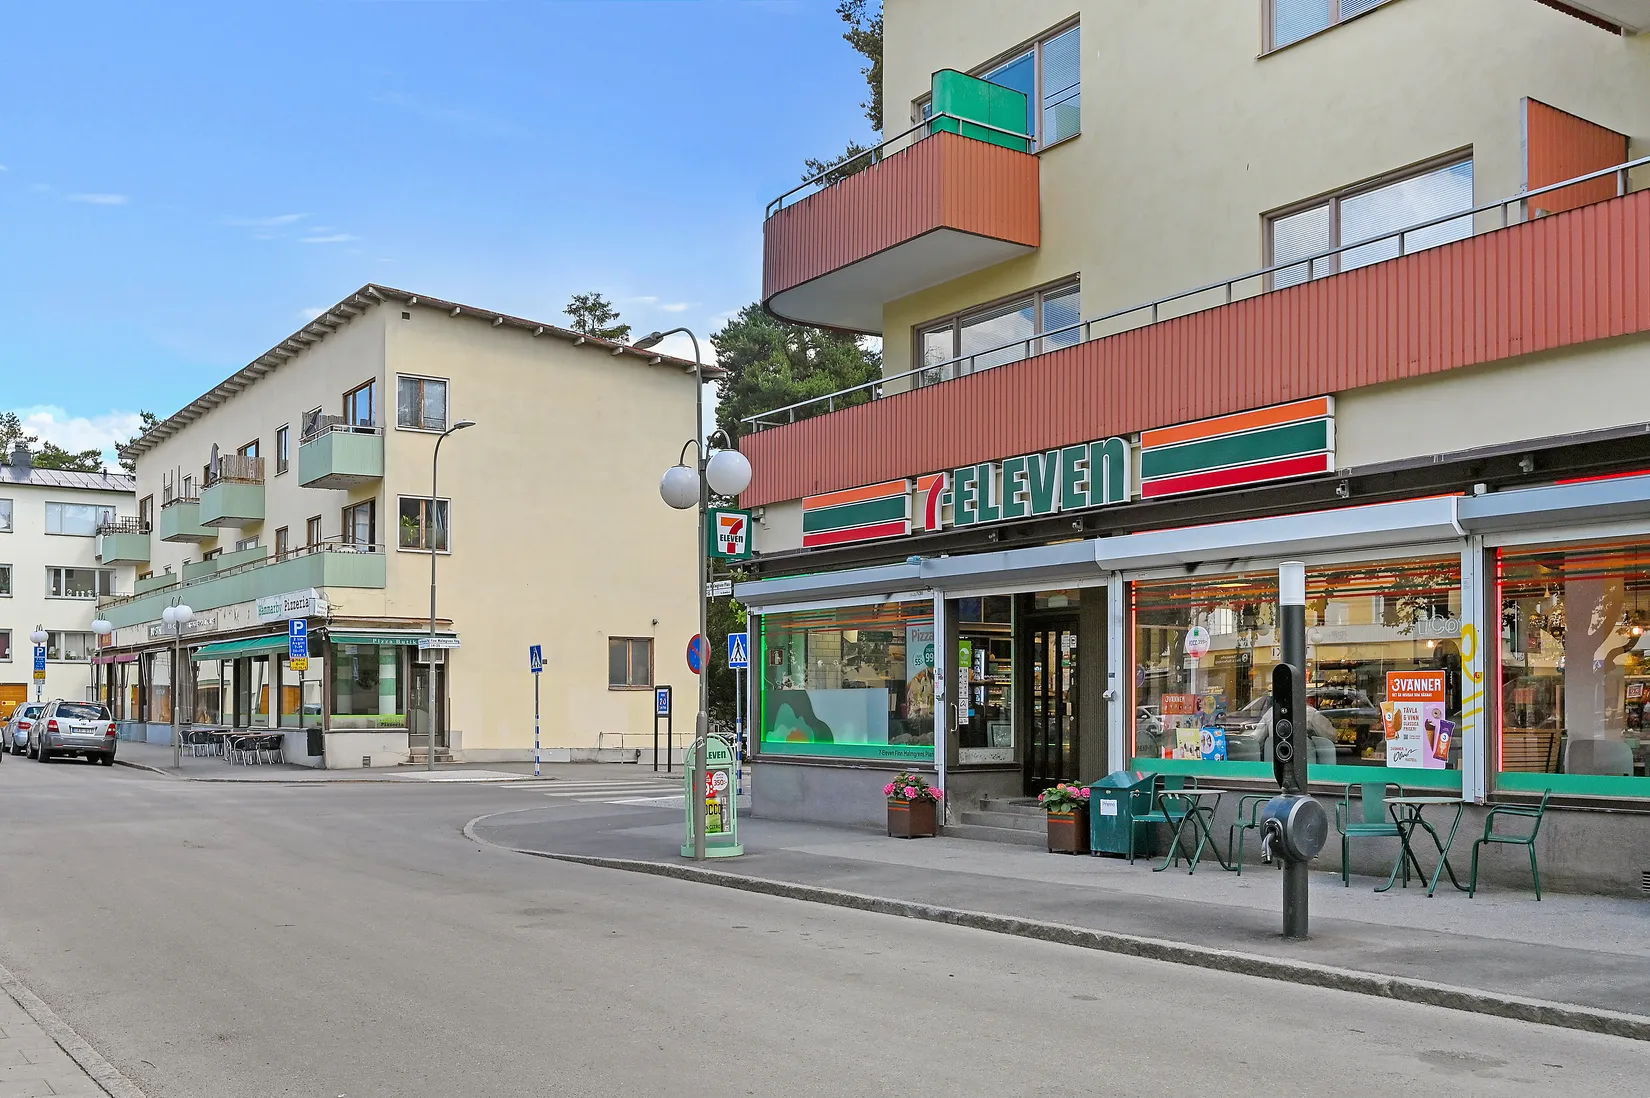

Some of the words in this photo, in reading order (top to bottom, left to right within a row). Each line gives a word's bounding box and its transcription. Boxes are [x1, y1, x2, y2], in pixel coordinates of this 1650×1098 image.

[721, 516, 743, 553] 7
[284, 596, 310, 611] Pizzeria
[293, 621, 304, 635] P
[912, 629, 934, 642] Pizza
[37, 648, 43, 656] P
[1391, 677, 1441, 692] 3VÄNNER
